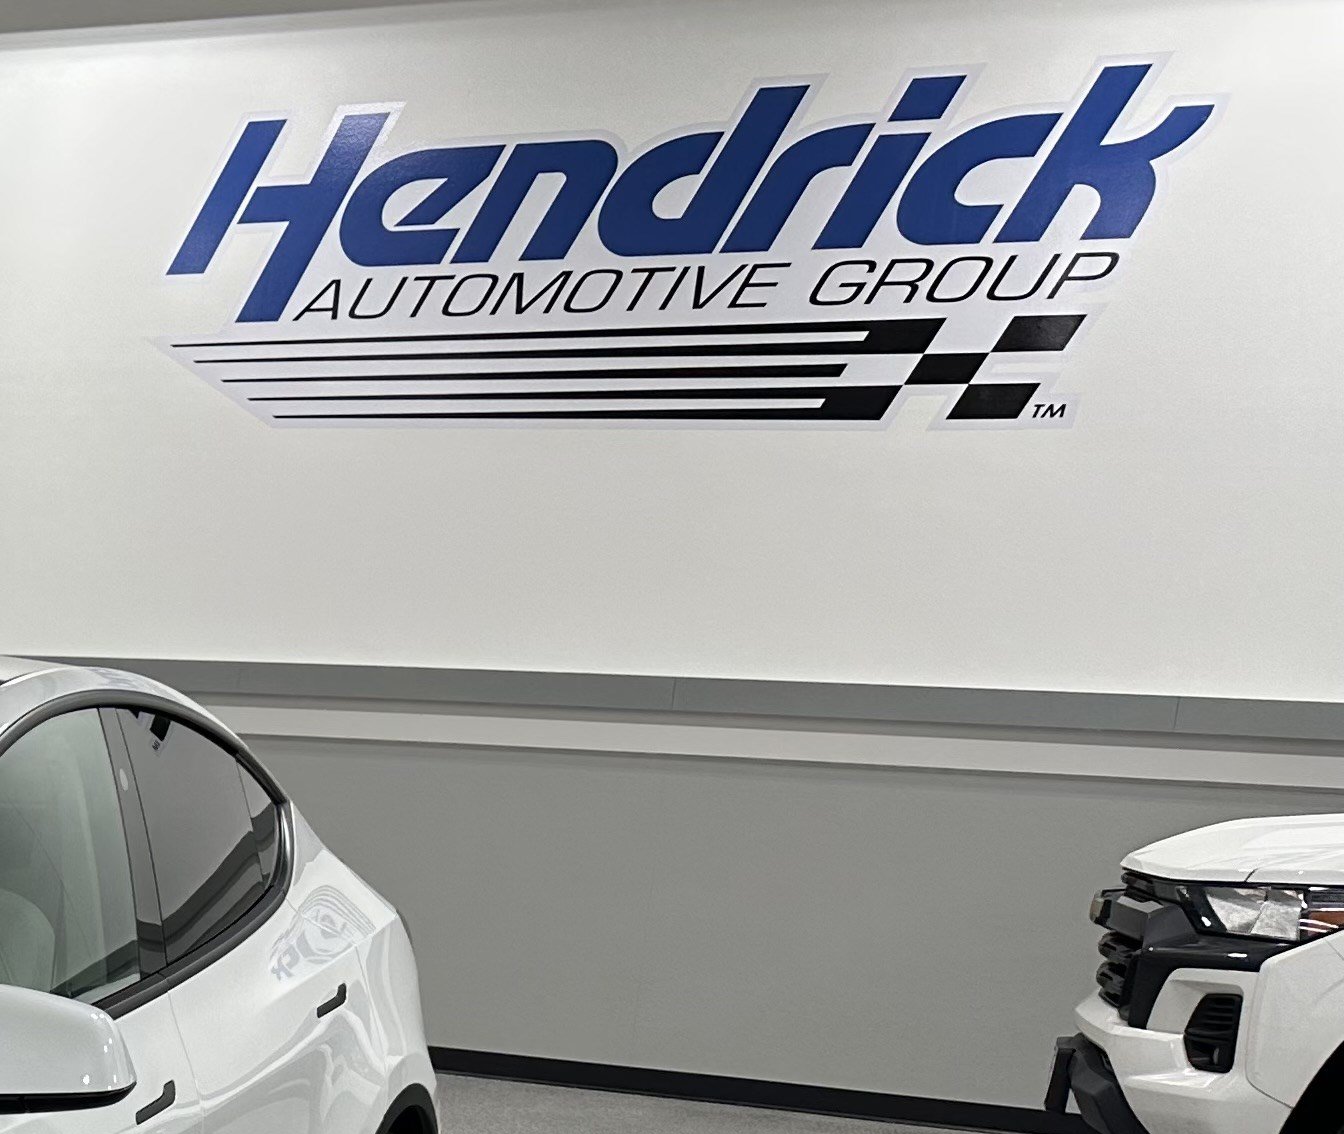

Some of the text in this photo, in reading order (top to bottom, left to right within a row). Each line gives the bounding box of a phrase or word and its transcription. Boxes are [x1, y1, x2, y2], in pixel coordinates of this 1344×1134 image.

[166, 64, 1213, 322] Hendrick
[292, 252, 1120, 323] AUTOMOTIVE GROUP
[1032, 403, 1067, 418] TM
